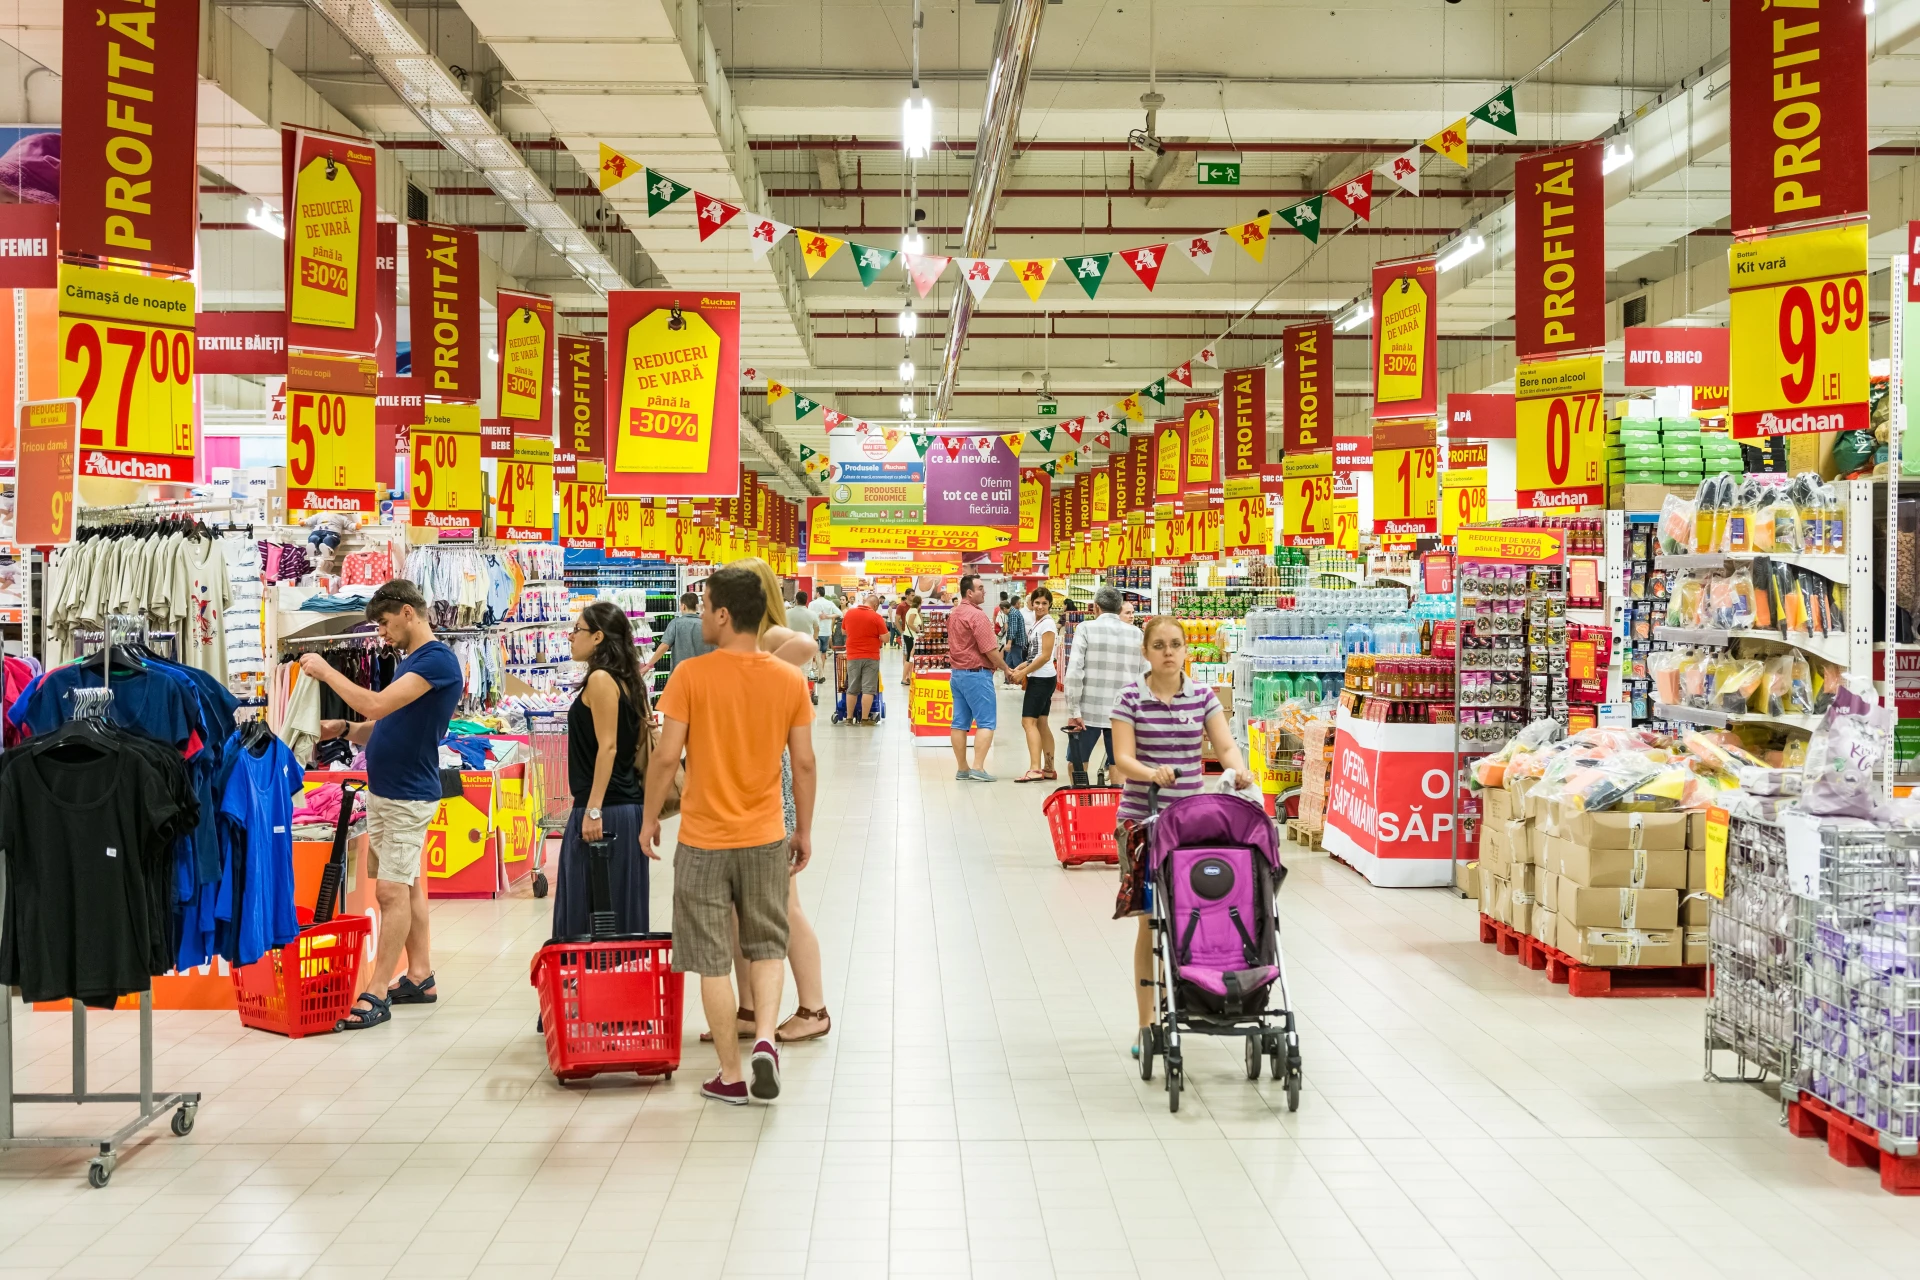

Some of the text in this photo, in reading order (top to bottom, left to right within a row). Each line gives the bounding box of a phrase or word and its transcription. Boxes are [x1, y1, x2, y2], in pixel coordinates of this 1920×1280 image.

[1761, 0, 1821, 213] PROFIT
[302, 200, 354, 218] REDUCERI
[306, 217, 351, 239] DE VARĂ
[313, 246, 343, 262] până la
[1535, 158, 1575, 345] PROFITĂ!
[1737, 250, 1758, 259] Bottari
[1737, 257, 1787, 275] Kit vară
[302, 261, 347, 291] -30%
[124, 293, 140, 306] de
[143, 296, 187, 313] noapte
[700, 297, 736, 306] Auchan
[425, 233, 459, 391] PROFITĂ!
[1384, 303, 1421, 327] REDUCERI
[1387, 317, 1420, 341] DE VARĂ
[197, 336, 243, 351] TEXTILE
[508, 335, 541, 348] REDUCERI
[1391, 343, 1413, 353] până la
[510, 347, 539, 362] DE VARĂ
[633, 345, 708, 371] REDUCERI
[1630, 350, 1703, 365] AUTO, BRICO
[1384, 356, 1416, 372] -30%
[291, 366, 331, 379] Tricou copii
[638, 363, 704, 391] DE VARĂ
[507, 376, 536, 396] -30%
[1519, 372, 1586, 388] Bere non alcool
[1294, 330, 1318, 445] PROFITĂ!
[1822, 373, 1841, 401] LEI
[401, 395, 421, 406] FETE
[569, 343, 591, 452] PROFITĂ!
[647, 395, 691, 409] până la
[31, 403, 67, 416] REDUCERI
[1454, 410, 1471, 421] APĂ
[434, 415, 451, 424] bebe
[631, 411, 697, 437] -30%
[1233, 373, 1253, 471] PROFITĂ!
[1757, 412, 1844, 436] Auchan
[175, 424, 192, 451] LEI
[22, 440, 68, 453] Tricou damă
[491, 441, 511, 450] BEBE
[1336, 443, 1358, 451] SIROP
[562, 452, 576, 462] PĂR
[931, 455, 943, 464] ce
[1190, 455, 1209, 466] -30%
[1336, 456, 1351, 465] SUC
[85, 451, 171, 479] Auchan
[845, 464, 879, 472] Produsele
[1586, 461, 1598, 481] LEI
[335, 465, 347, 487] LEI
[1136, 438, 1148, 506] PROFITĂ!
[980, 476, 1012, 488] Oferim
[1262, 475, 1275, 483] SUC
[864, 486, 907, 494] PRODUSELE
[1115, 456, 1127, 518] PROFITĂ!
[303, 491, 361, 510] Auchan
[448, 492, 458, 508] LEI
[864, 494, 907, 502] ECONOMICE
[943, 488, 1012, 501] tot ce e util
[1532, 490, 1588, 507] Auchan
[1079, 475, 1089, 528] PROFITĂ!
[1426, 500, 1435, 516] LEI
[849, 510, 878, 518] Auchan
[969, 503, 1011, 514] fiecăruia.
[424, 512, 470, 527] Auchan
[506, 527, 543, 540] Auchan
[849, 527, 917, 536] REDUCERI
[943, 528, 979, 538] VARĂ
[1384, 521, 1426, 534] Auchan
[567, 536, 597, 548] Auchan
[860, 537, 891, 545] până
[908, 537, 977, 549] -30%
[1293, 535, 1326, 546] Auchan
[1468, 533, 1542, 546] REDUCERI DE VARĂ
[612, 548, 636, 557] Auchan
[1233, 547, 1259, 556] Auchan
[1389, 543, 1411, 551] Auchan
[1475, 545, 1493, 553] până
[1501, 545, 1540, 558] -30%
[1160, 557, 1181, 565] Auchan
[1190, 552, 1214, 562] Auchan
[936, 689, 949, 699] DE
[917, 706, 926, 716] la
[1342, 748, 1369, 789] OFERTA
[1264, 770, 1291, 782] până
